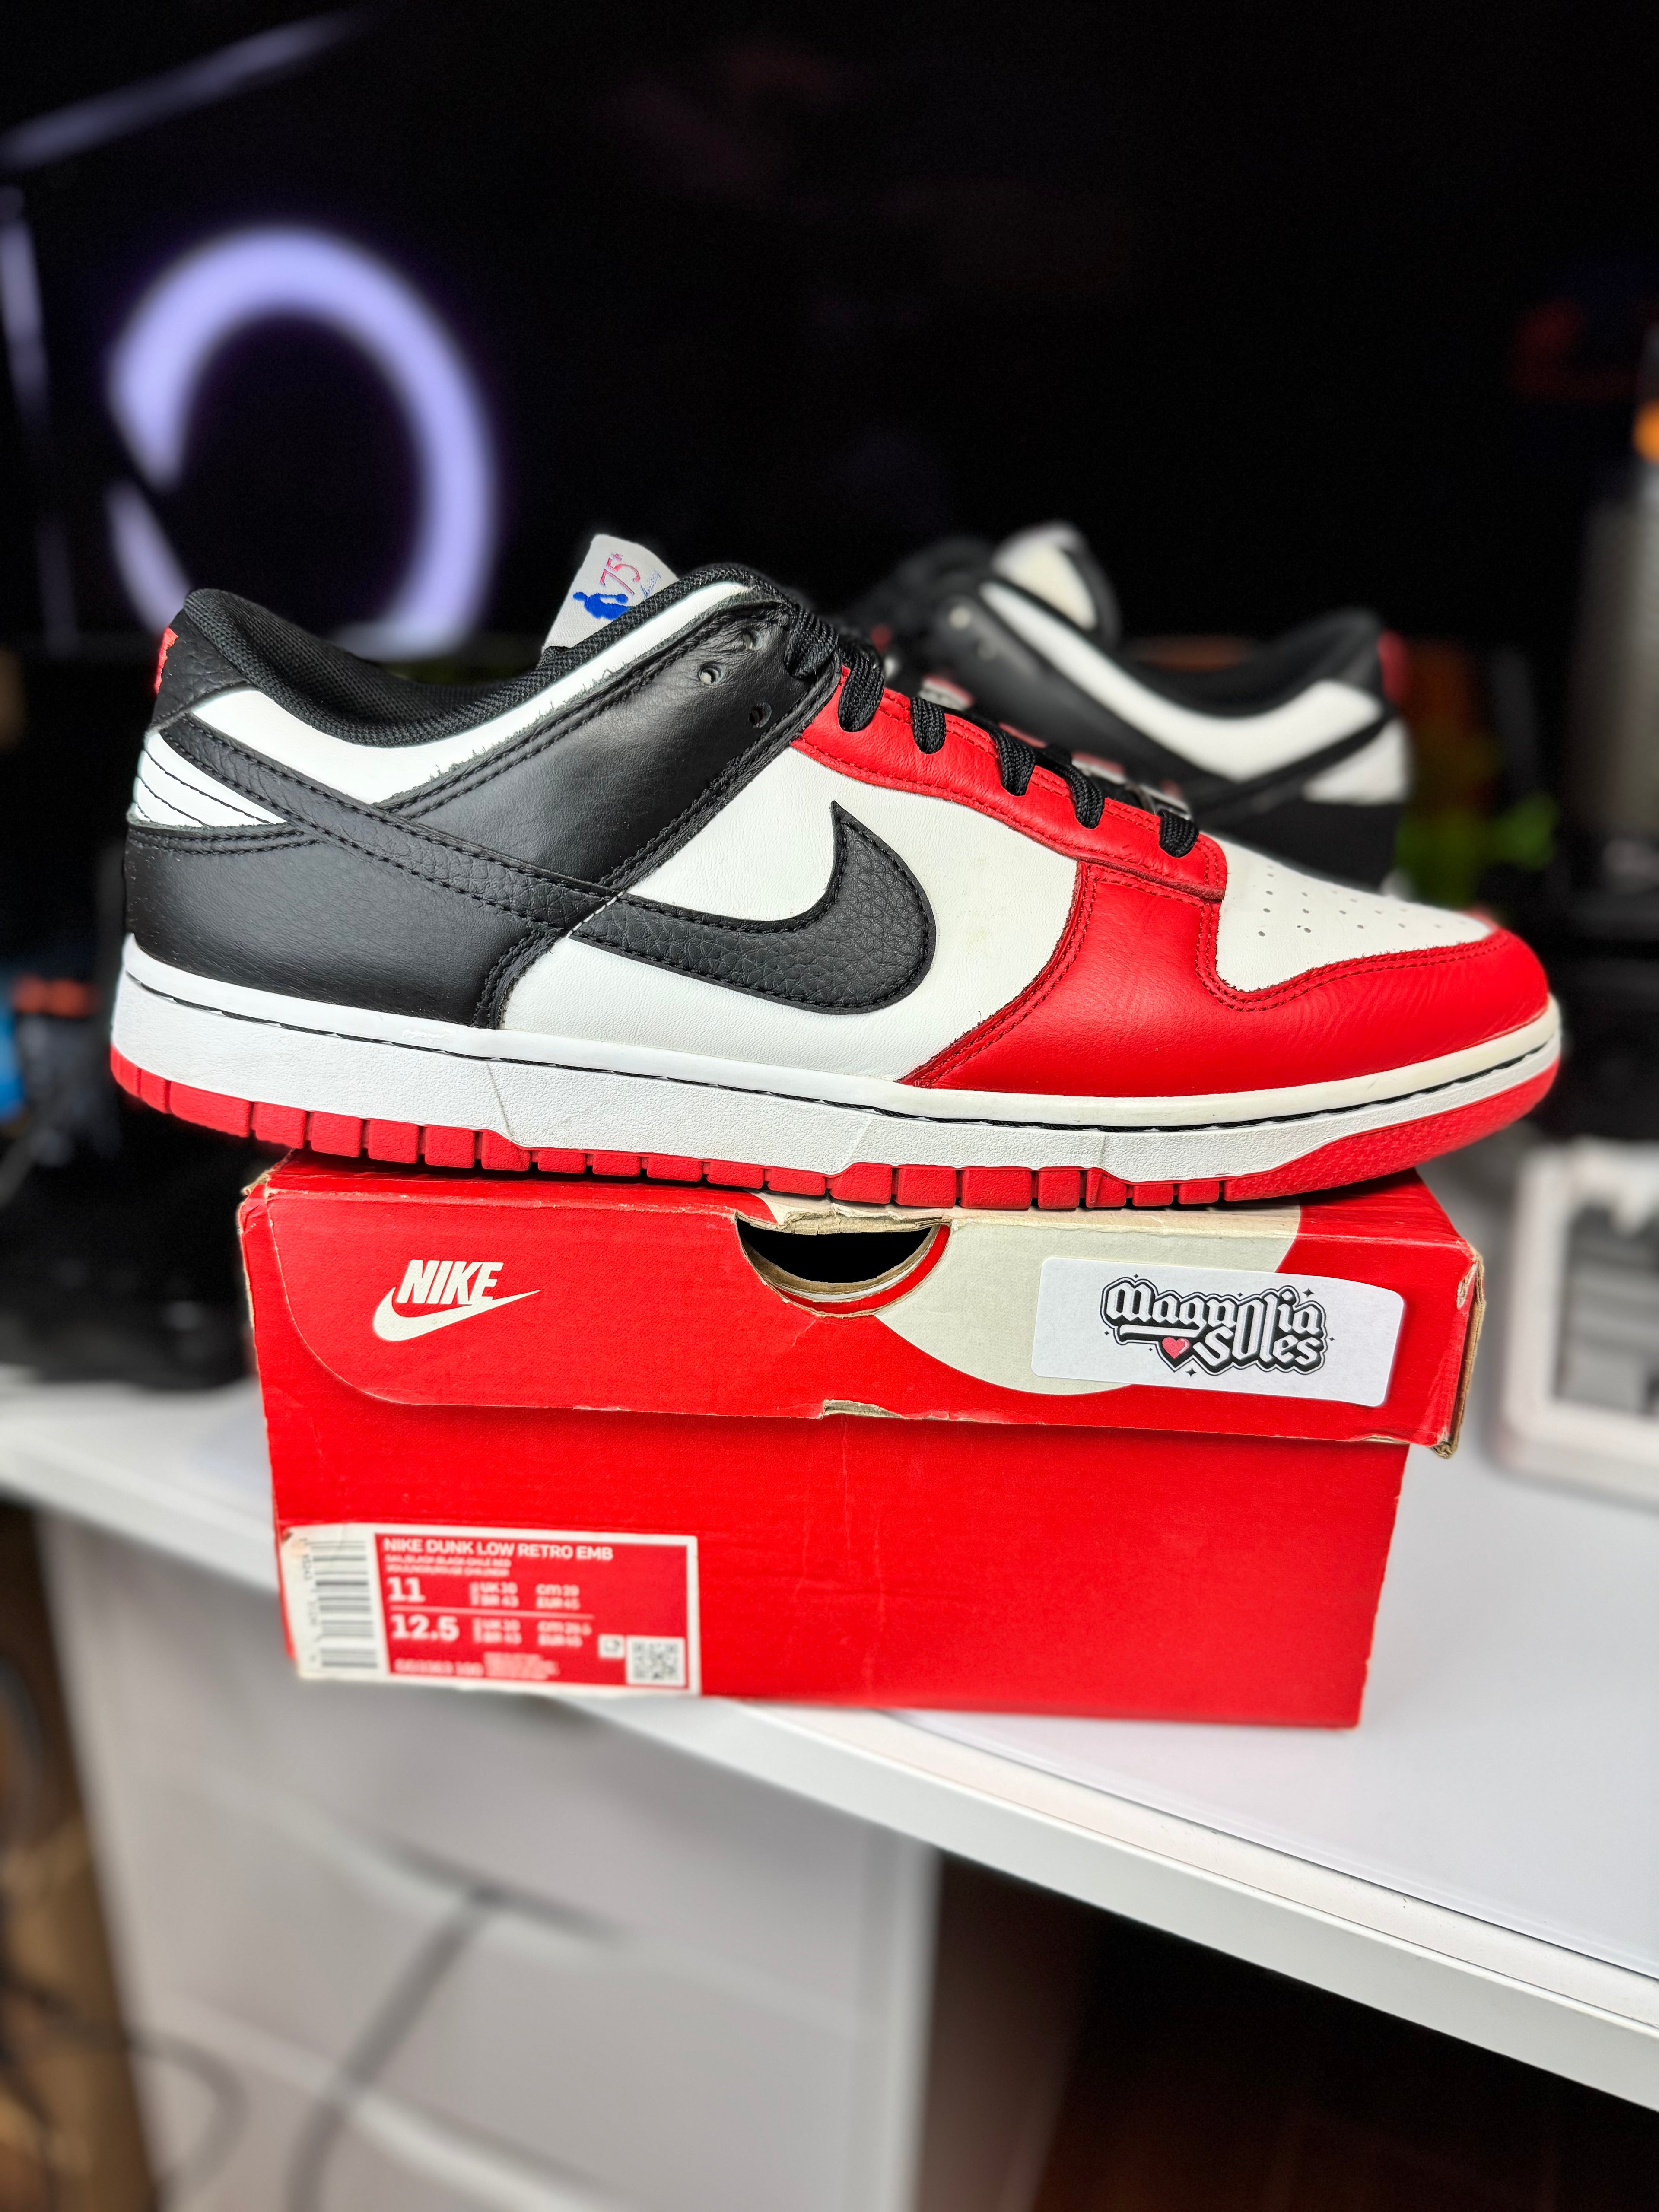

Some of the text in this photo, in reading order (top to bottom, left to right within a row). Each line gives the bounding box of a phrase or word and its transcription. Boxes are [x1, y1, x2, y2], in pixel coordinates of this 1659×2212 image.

[396, 1259, 504, 1305] NIKE
[383, 1538, 613, 1560] NIKE DUNK LOW RETRO EMB
[387, 1576, 426, 1603] 11
[480, 1581, 518, 1594] UK 10
[536, 1583, 561, 1596] cm
[391, 1614, 460, 1642] 12.5
